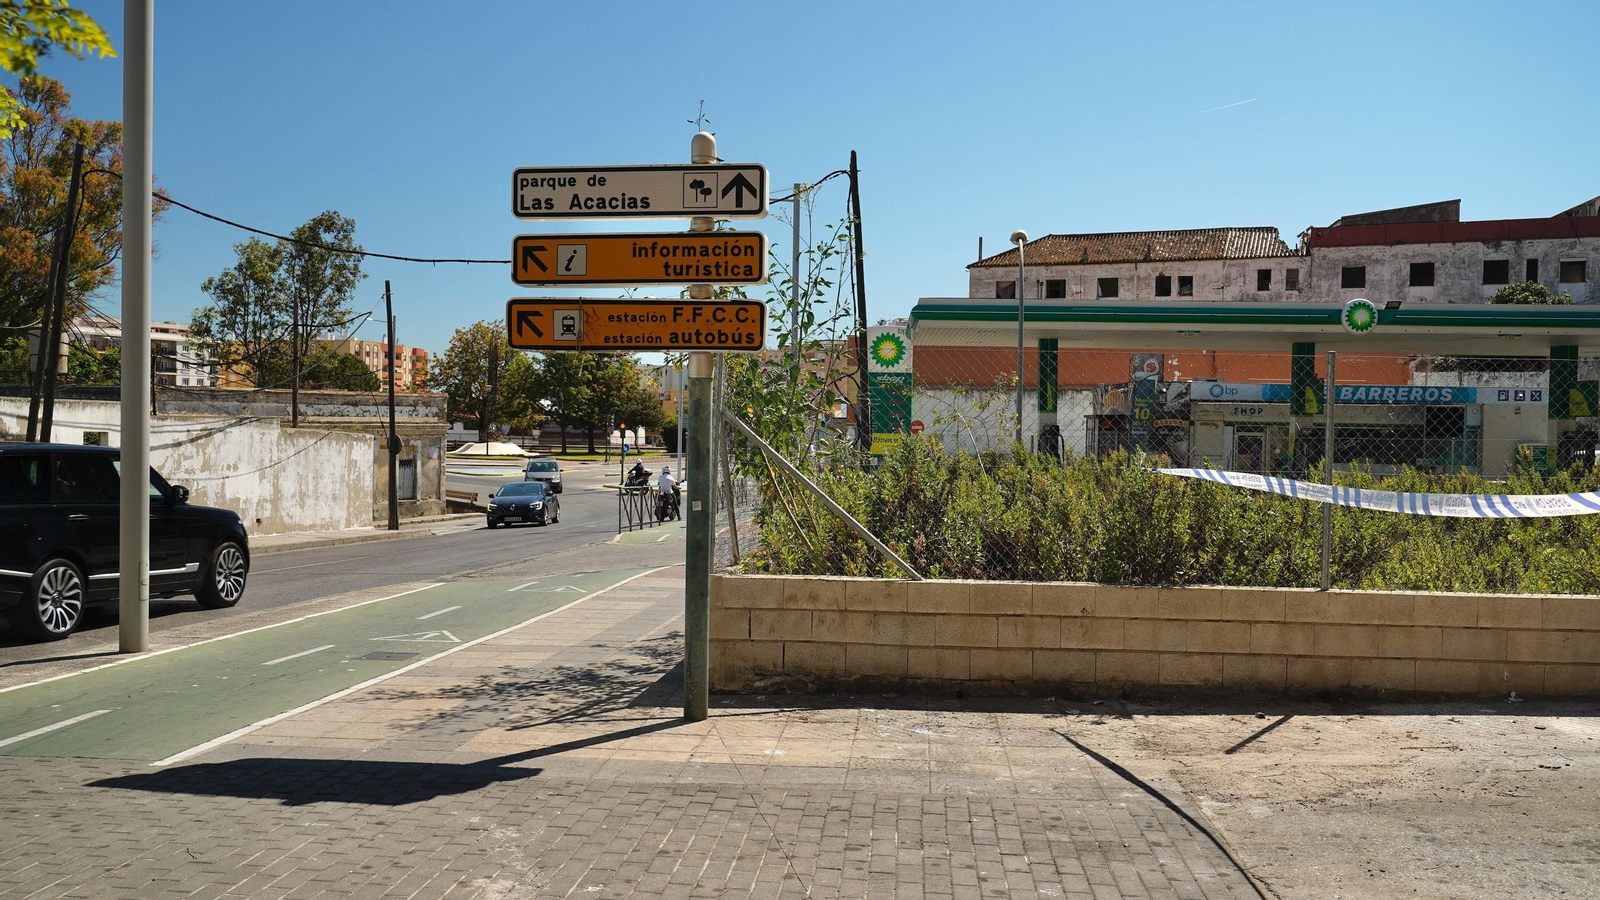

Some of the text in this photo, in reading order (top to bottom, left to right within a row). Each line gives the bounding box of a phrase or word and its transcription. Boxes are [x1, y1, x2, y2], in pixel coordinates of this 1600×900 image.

[519, 174, 607, 191] parque de
[519, 193, 651, 211] Las Acacias
[631, 238, 755, 258] información
[663, 260, 754, 277] turística
[607, 306, 756, 323] estación F.F.C.C.
[603, 326, 756, 345] estación autobús
[1225, 386, 1238, 396] bp
[1339, 387, 1454, 402] BARREROS
[1133, 408, 1151, 420] 10
[1234, 407, 1263, 415] SHOP
